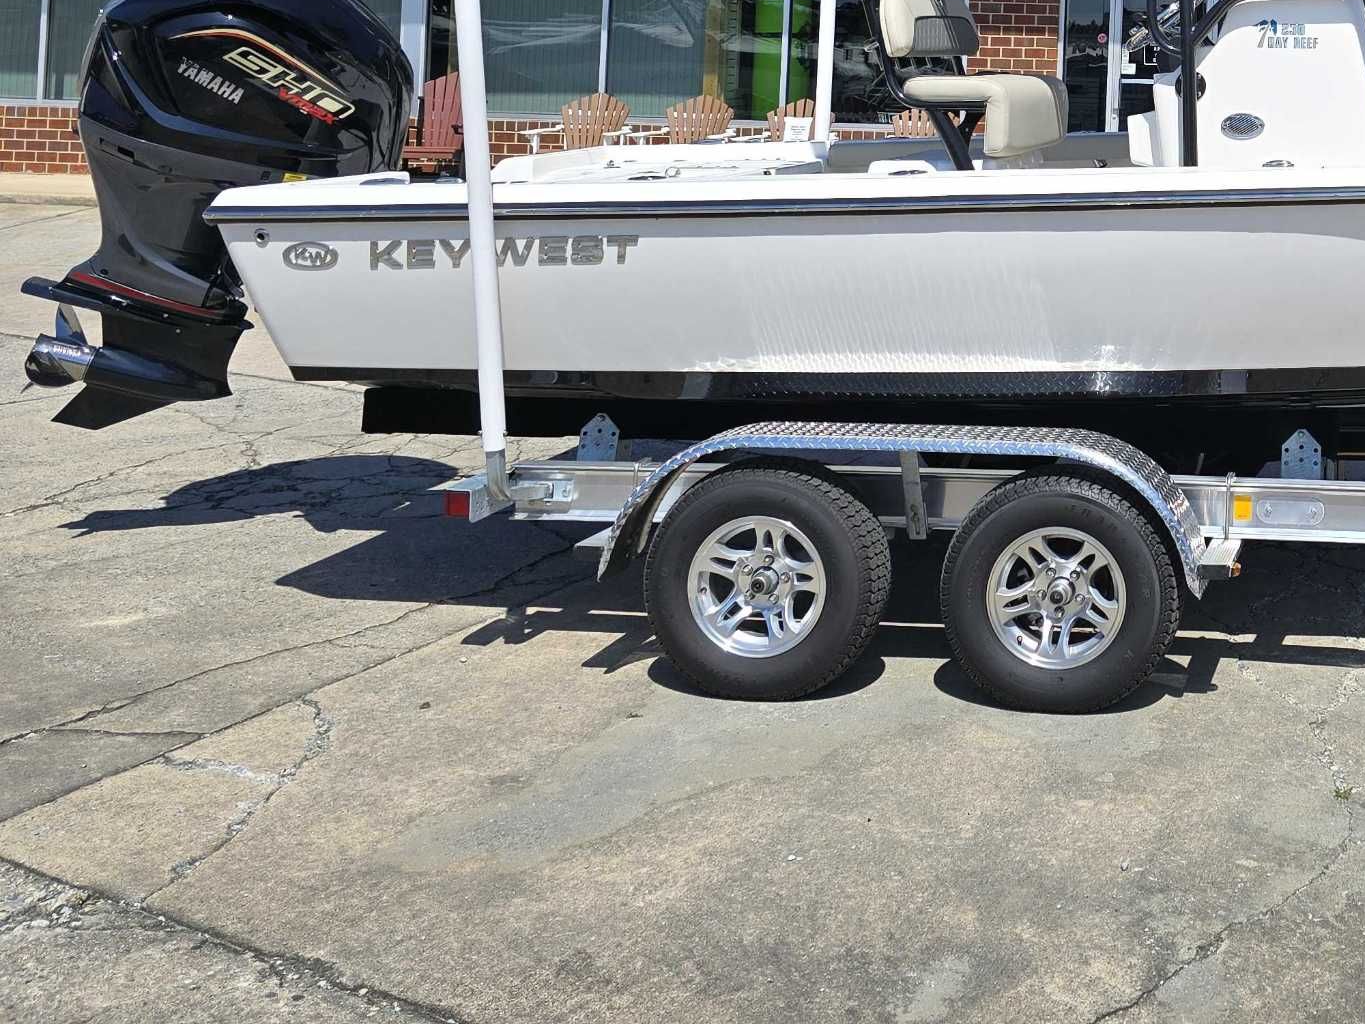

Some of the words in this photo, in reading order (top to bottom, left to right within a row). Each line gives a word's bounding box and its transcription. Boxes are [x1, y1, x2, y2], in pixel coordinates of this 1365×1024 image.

[1267, 36, 1289, 49] BAY
[176, 60, 246, 105] YAMAHA
[222, 46, 356, 119] SHO
